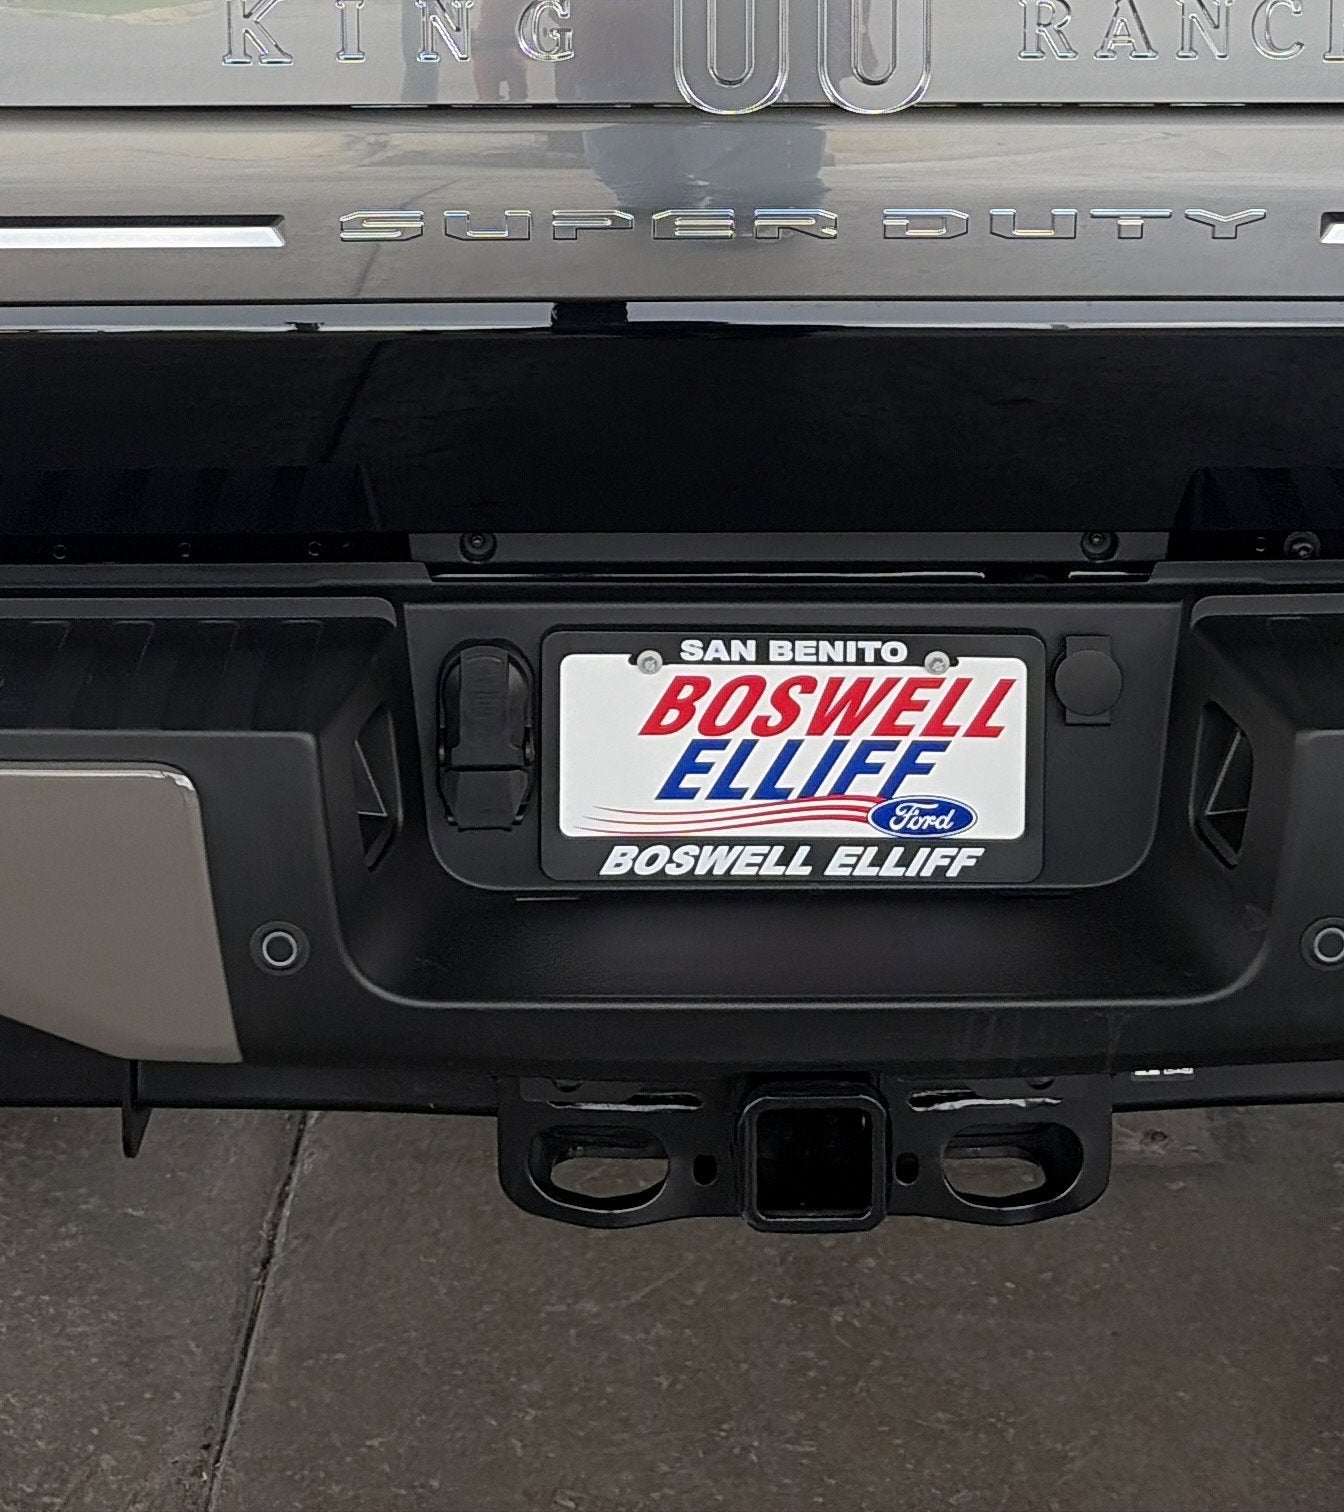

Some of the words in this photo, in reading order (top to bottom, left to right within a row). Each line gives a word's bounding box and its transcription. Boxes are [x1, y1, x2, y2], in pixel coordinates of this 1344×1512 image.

[340, 209, 839, 241] SUPER
[882, 208, 1267, 240] DUTY
[679, 640, 756, 663] SAN
[769, 640, 908, 664] BENITO
[638, 675, 1017, 738] BOSWELL
[655, 738, 951, 801] ELLIFF
[889, 802, 956, 831] Ford
[599, 845, 813, 876] BOSWELL
[823, 846, 986, 878] ELLIFF
